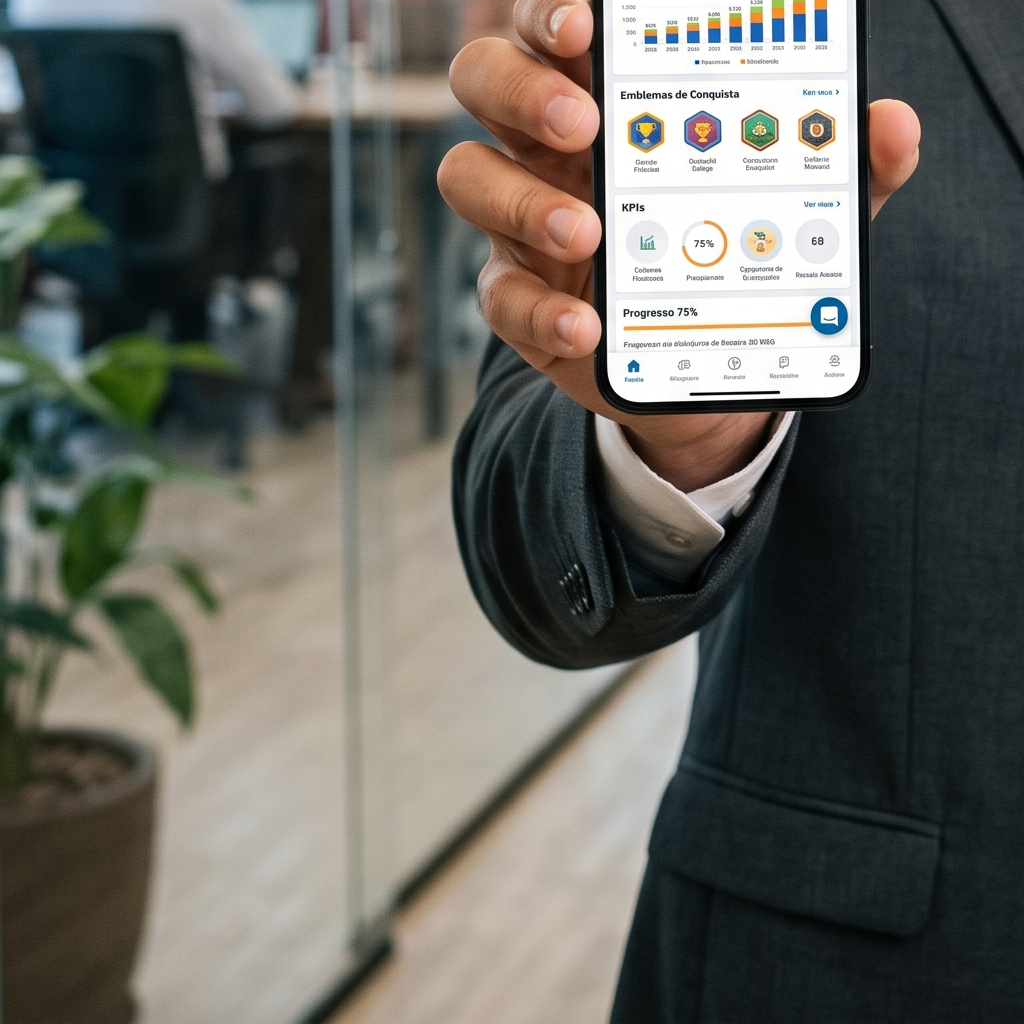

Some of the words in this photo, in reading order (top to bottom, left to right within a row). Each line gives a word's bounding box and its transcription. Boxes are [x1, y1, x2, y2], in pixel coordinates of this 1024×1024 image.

[620, 90, 673, 100] Emblemas
[675, 90, 688, 99] de
[689, 89, 740, 101] Conquista
[621, 203, 645, 212] KPIs
[693, 239, 715, 248] 75%
[811, 236, 824, 246] 68
[623, 308, 675, 320] Progresso
[676, 307, 698, 317] 75%
